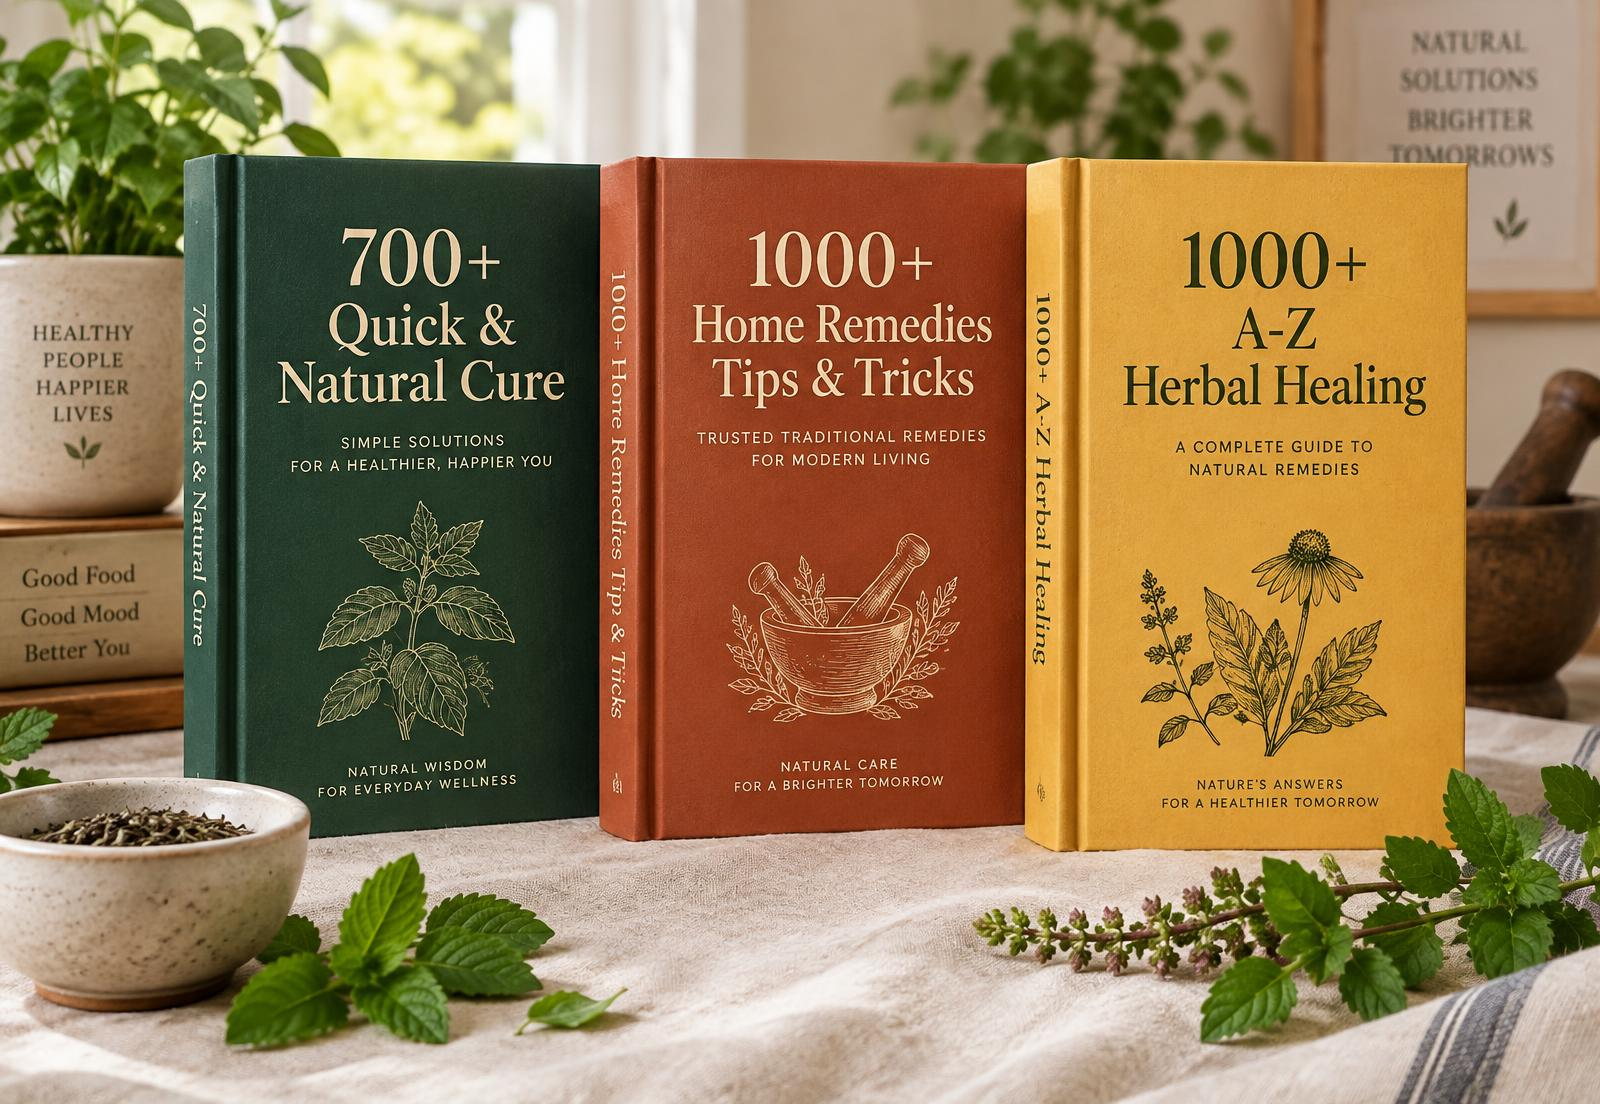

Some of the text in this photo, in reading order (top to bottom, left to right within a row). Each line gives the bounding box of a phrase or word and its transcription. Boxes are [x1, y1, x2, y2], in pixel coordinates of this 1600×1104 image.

[1412, 30, 1528, 53] NATURAL
[1399, 68, 1538, 93] SOLUTIONS
[1407, 108, 1532, 133] BRIGHTER
[1389, 144, 1554, 167] TOMORROWS
[341, 227, 500, 288] 700+
[748, 230, 933, 288] 1000+
[1182, 230, 1367, 290] 1000+
[33, 324, 134, 342] HEALTHY
[328, 300, 517, 357] Quick &
[692, 302, 993, 344] Home Remedies
[1231, 306, 1317, 350] A-Z
[44, 351, 124, 369] PEOPLE
[37, 379, 130, 396] HAPPIER
[277, 358, 565, 404] Natural Cure
[711, 355, 974, 409] Tips & Tricks
[1122, 362, 1427, 417] Herbal Healing
[54, 405, 113, 423] LIVES
[341, 434, 504, 450] SIMPLE SOLUTIONS
[696, 429, 986, 445] TRUSTED TRADITIONAL REMEDIES
[1175, 440, 1373, 454] A COMPLETE GUIDE TO
[291, 455, 552, 473] FOR A HEALTHIER, HAPPIER YOU
[752, 452, 930, 467] FOR MODERN LIVING
[1189, 462, 1359, 476] NATURAL REMEDIES
[189, 303, 208, 647] 700+ Quick & Natural Cure
[1032, 292, 1052, 666] 1000+ A-Z Herbal Healing
[21, 563, 136, 589] Good Food
[20, 601, 140, 628] Good Mood
[611, 623, 626, 643] &
[25, 638, 130, 663] Better You
[348, 758, 487, 778] NATURAL WISDOM
[781, 758, 898, 773] NATURAL CARE
[318, 774, 517, 798] FOR EVERYDAY WELLNESS
[734, 775, 944, 793] FOR A BRIGHTER TOMORROW
[1197, 778, 1343, 791] NATURE'S ANSWERS
[1161, 796, 1379, 809] FOR A HEALTHIER TOMORROW
